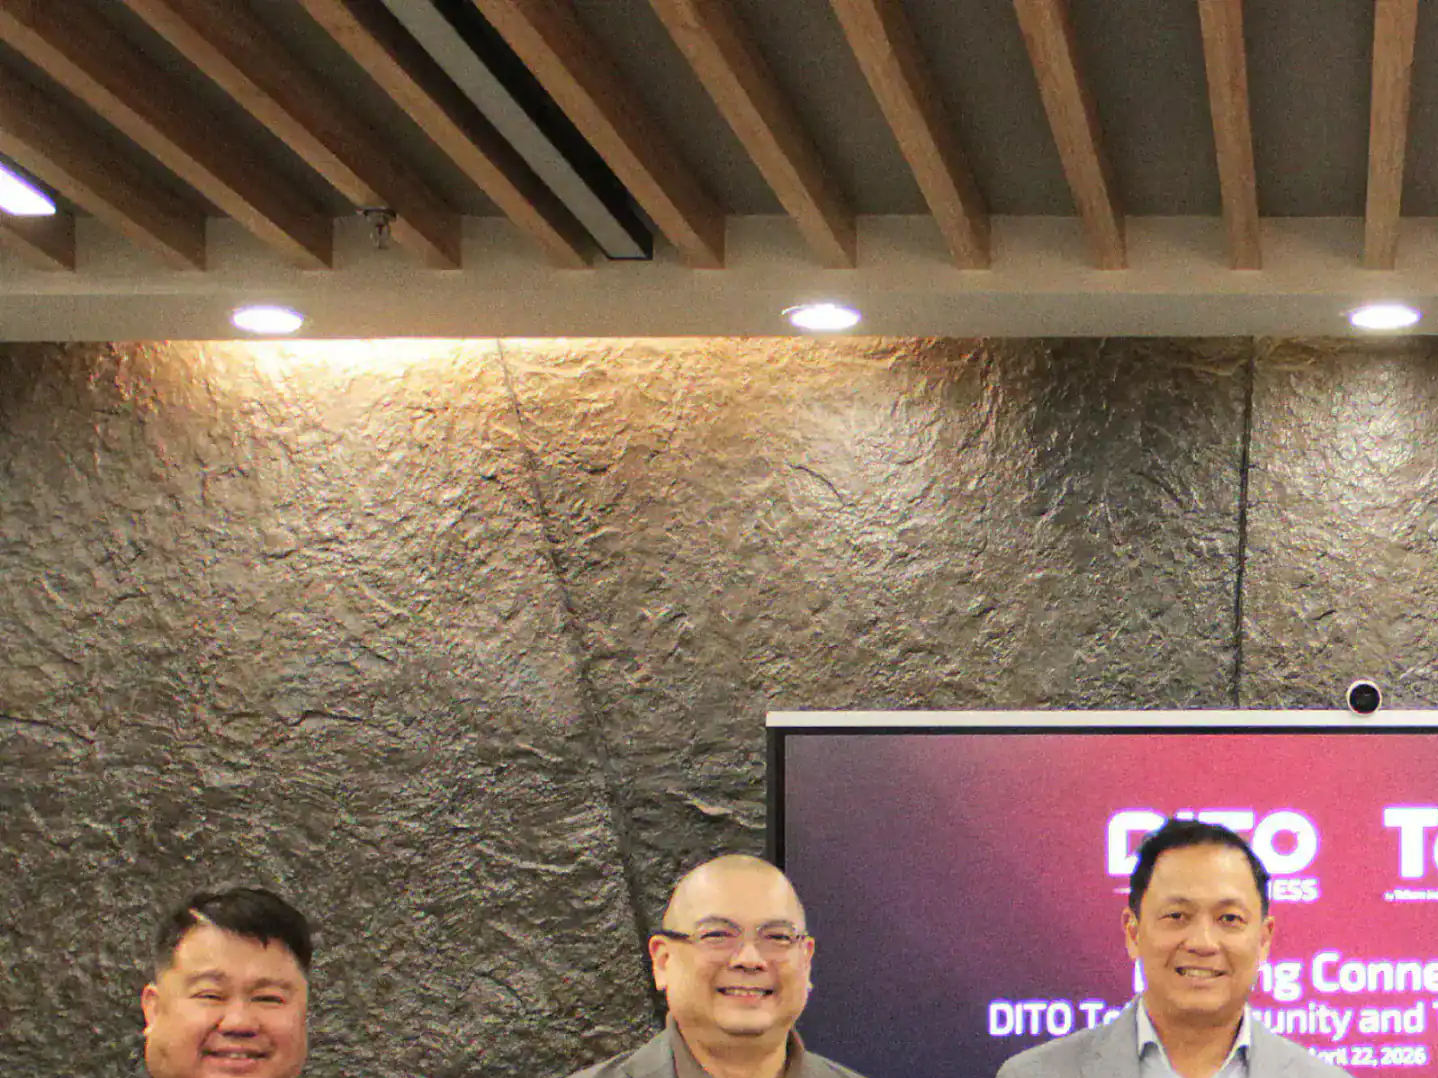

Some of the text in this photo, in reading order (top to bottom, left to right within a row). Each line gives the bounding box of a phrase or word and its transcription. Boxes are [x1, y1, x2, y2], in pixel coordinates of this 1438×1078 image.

[988, 1001, 1073, 1036] DITO
[1358, 1001, 1425, 1034] and
[1350, 1046, 1378, 1067] 22,
[1380, 1046, 1427, 1066] 2026
